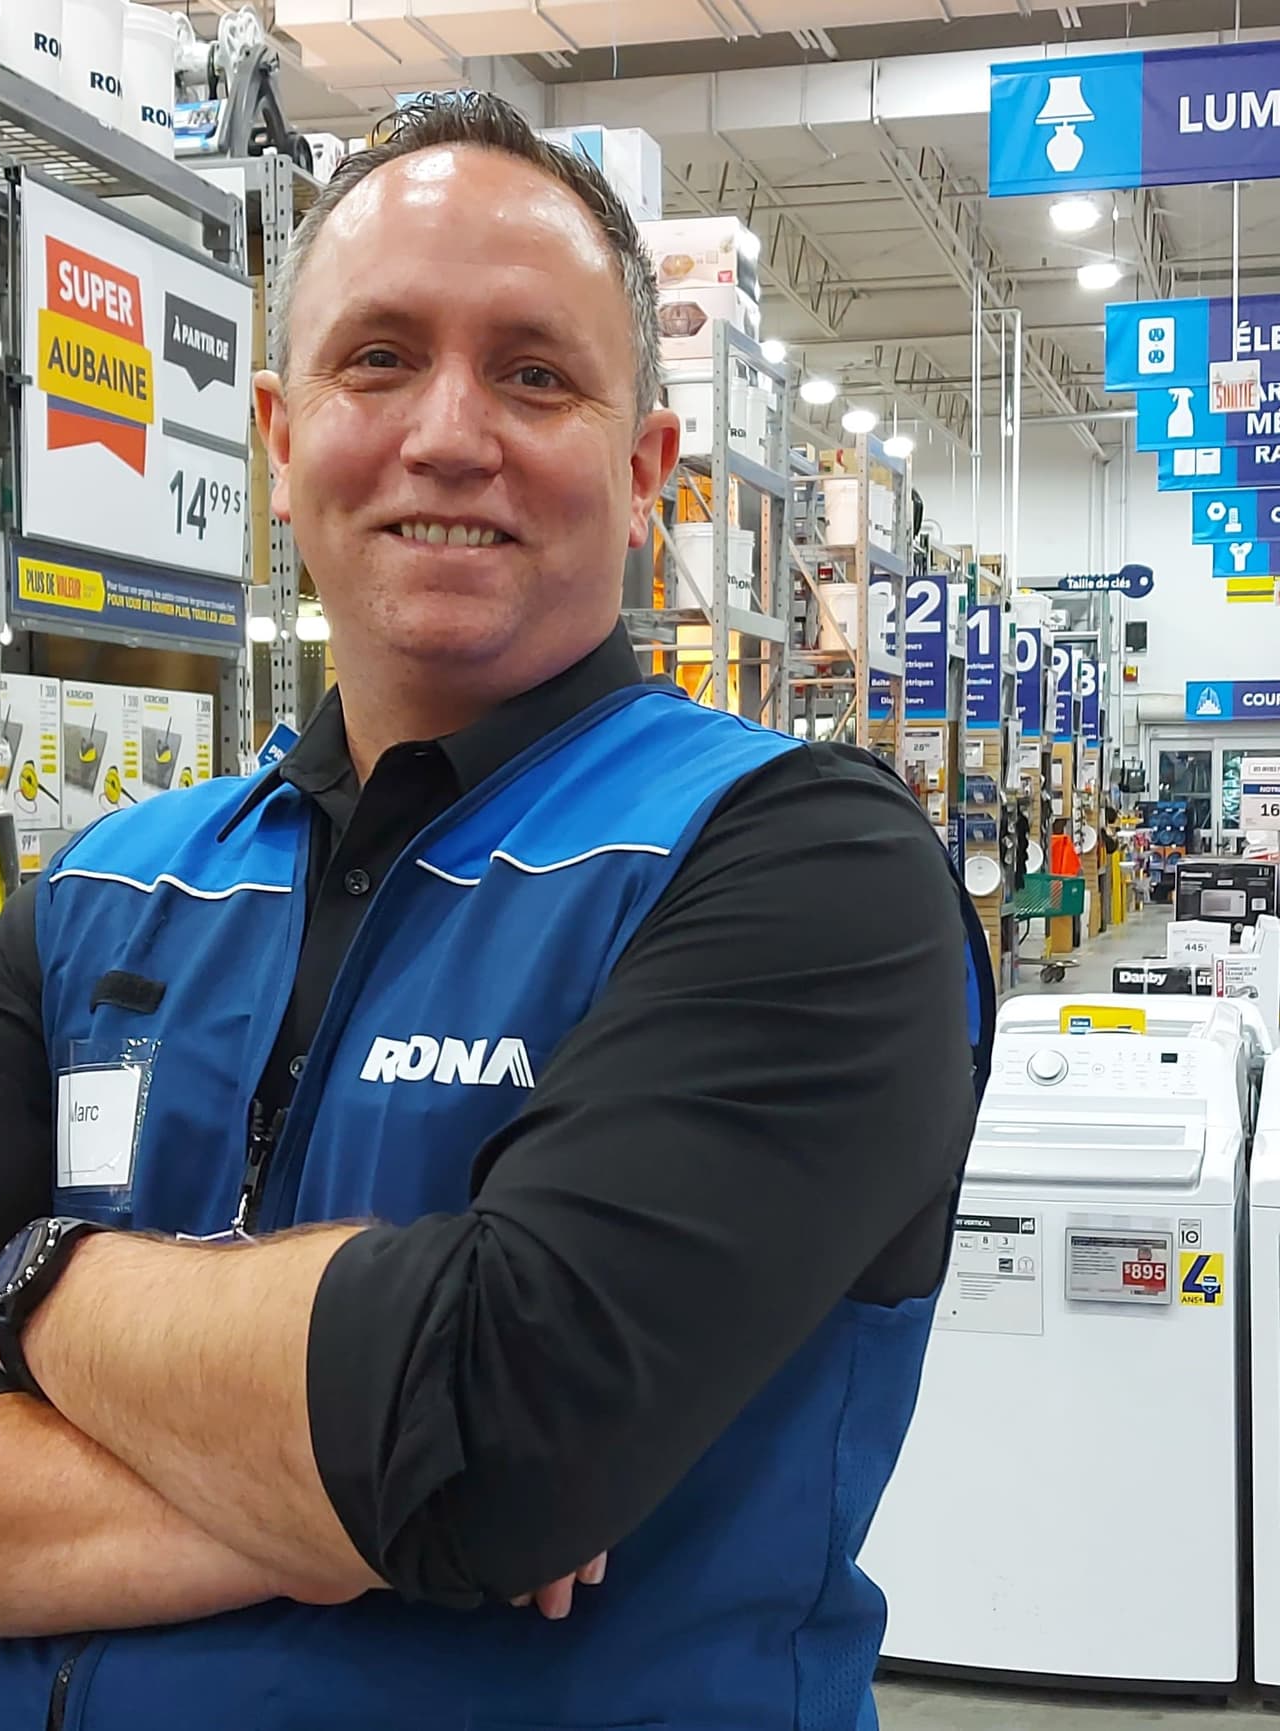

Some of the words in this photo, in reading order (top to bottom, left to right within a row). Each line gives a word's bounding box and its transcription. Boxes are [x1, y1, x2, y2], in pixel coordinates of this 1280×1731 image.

[33, 32, 62, 61] RO
[58, 259, 135, 327] SUPER
[182, 326, 216, 354] PARTIR
[217, 341, 230, 362] DE
[48, 336, 148, 401] AUBAINE
[26, 568, 45, 594] PLUS
[46, 573, 56, 596] DE
[1066, 577, 1095, 590] Taille
[1097, 578, 1109, 590] de
[1111, 577, 1131, 589] clés
[966, 609, 990, 655] 1
[1016, 631, 1038, 672] 0
[1119, 971, 1168, 986] Danby
[360, 1035, 536, 1089] RONA
[1124, 1263, 1166, 1281] $895
[1181, 1254, 1222, 1303] 4
